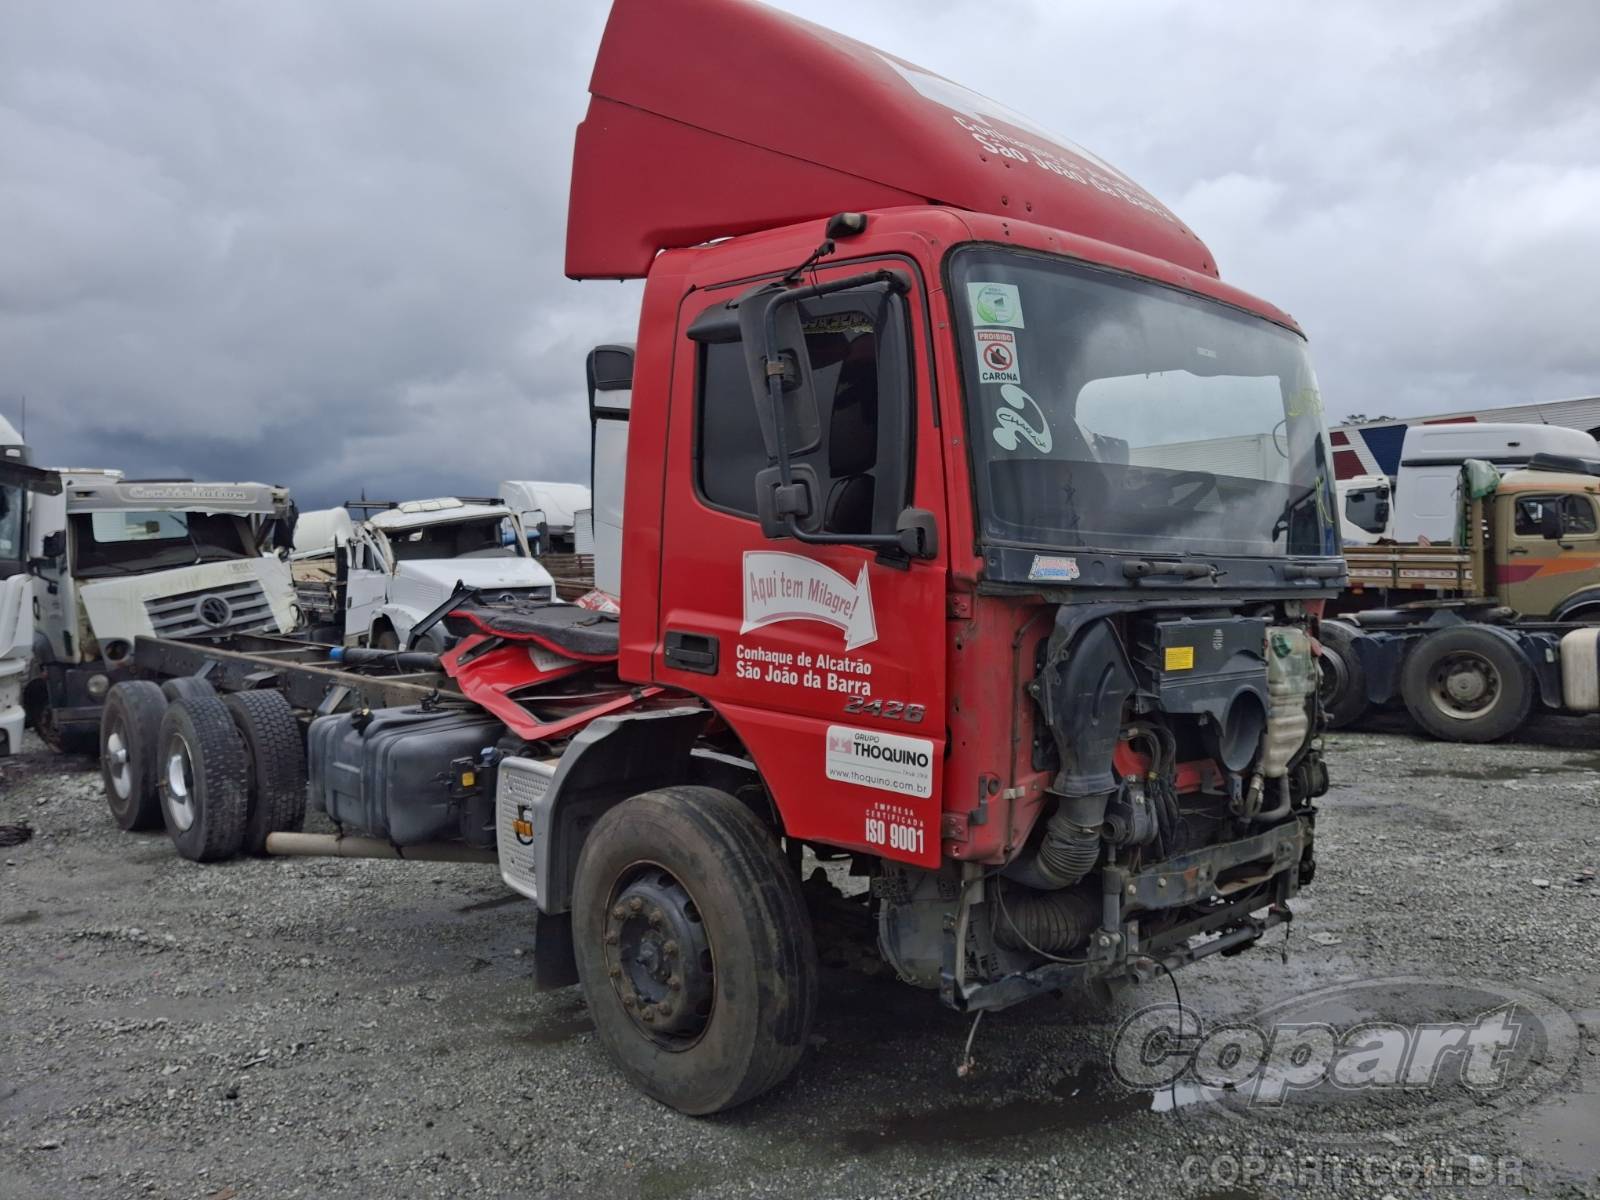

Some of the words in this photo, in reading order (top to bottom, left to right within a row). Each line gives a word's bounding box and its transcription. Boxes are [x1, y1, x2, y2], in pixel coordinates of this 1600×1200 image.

[972, 133, 1029, 163] São
[979, 333, 1012, 342] PROIBIDO
[982, 372, 1018, 381] CARONA
[750, 570, 777, 606] Aqui
[781, 572, 803, 599] tem
[808, 578, 859, 620] Milagre!
[736, 644, 793, 666] Conhaque
[797, 651, 812, 667] de
[816, 654, 872, 675] Alcatrão
[736, 661, 761, 680] São
[765, 665, 798, 686] João
[803, 670, 821, 689] da
[827, 672, 871, 696] Barra
[843, 695, 926, 723] 2426
[854, 733, 880, 743] GRUPO
[853, 742, 929, 768] THOQUINO
[830, 768, 927, 793] www.thoquino.com.br
[874, 802, 914, 816] EMPRESA
[865, 817, 885, 845] ISO
[890, 823, 924, 854] 9001
